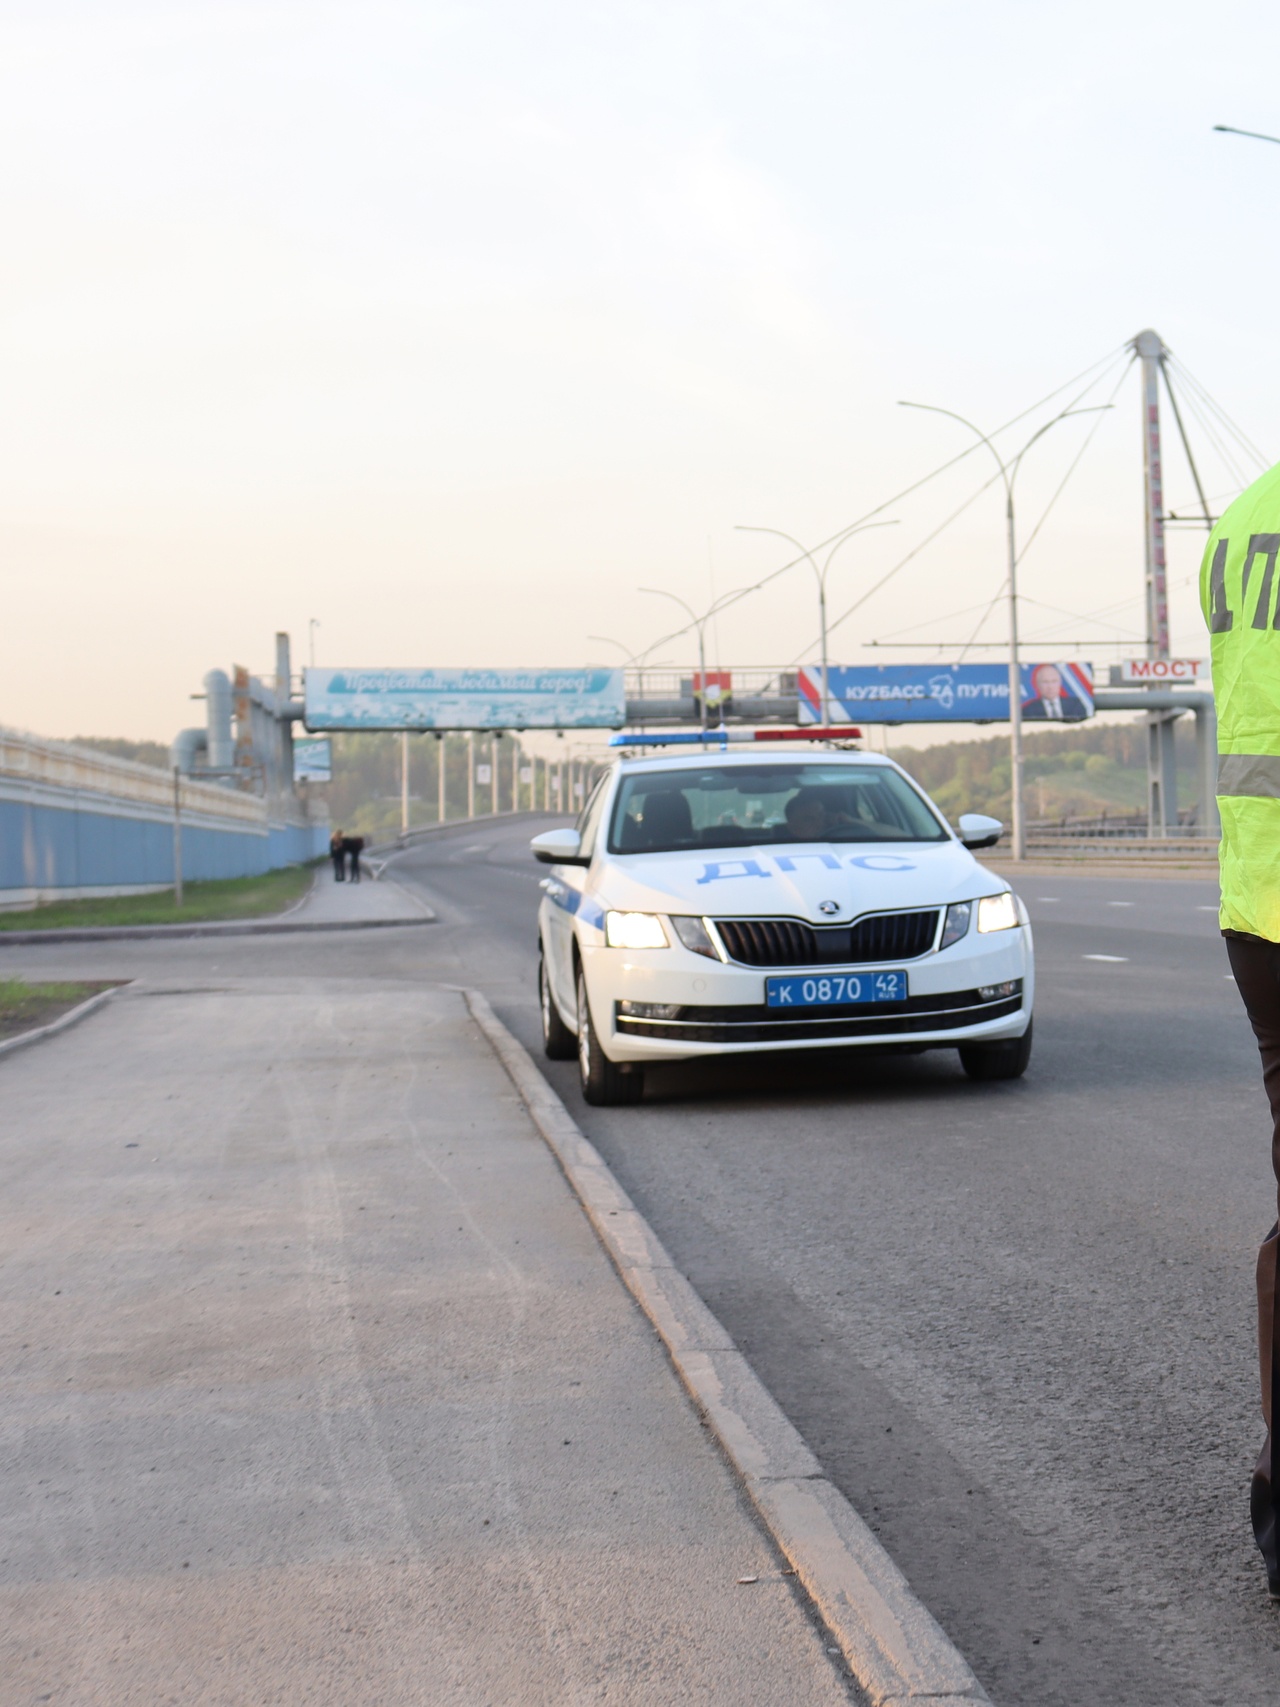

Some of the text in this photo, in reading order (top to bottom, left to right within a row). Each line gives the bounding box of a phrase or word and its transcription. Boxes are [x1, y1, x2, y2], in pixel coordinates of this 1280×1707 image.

[1131, 660, 1202, 677] МОСТ
[696, 853, 918, 885] ДПС
[802, 977, 861, 1002] 0870
[875, 974, 898, 992] 42
